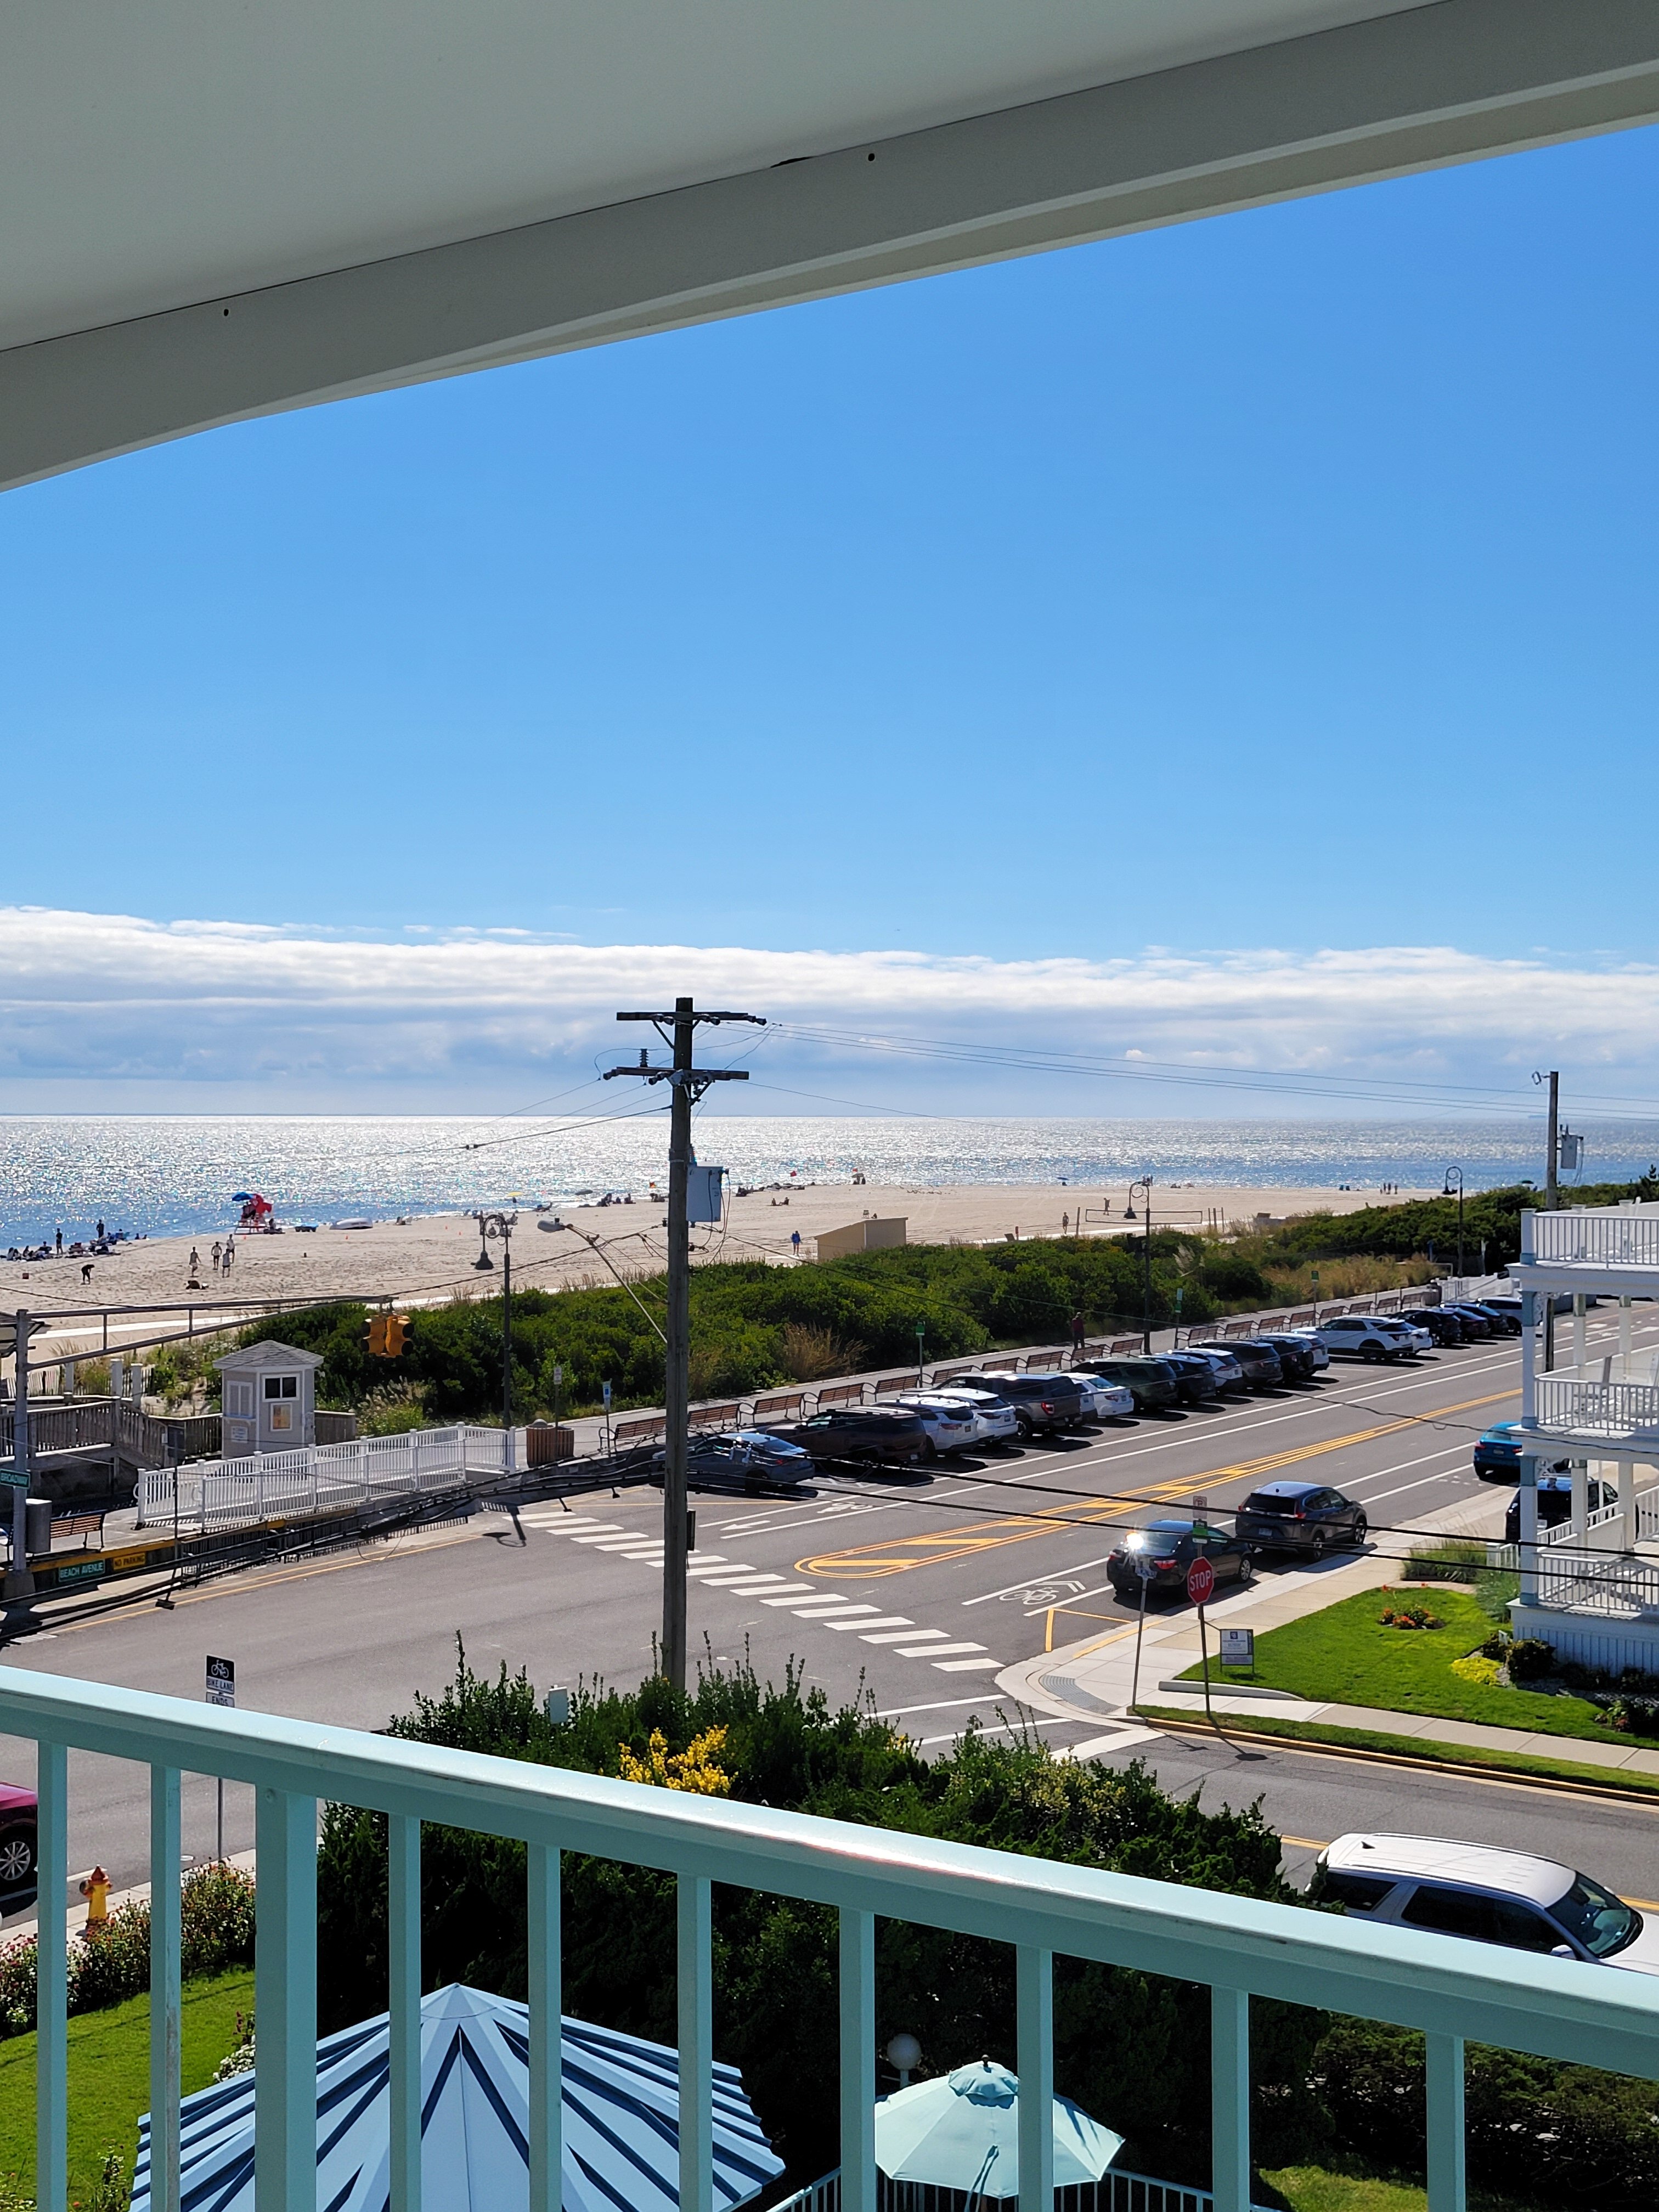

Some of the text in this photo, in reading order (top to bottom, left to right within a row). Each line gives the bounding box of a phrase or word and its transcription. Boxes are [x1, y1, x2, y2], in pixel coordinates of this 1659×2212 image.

[60, 1562, 103, 1578] BEACH AVENUE
[1190, 1570, 1211, 1592] STOP
[207, 1678, 234, 1691] BIKE LANE
[212, 1696, 229, 1706] ENDS
